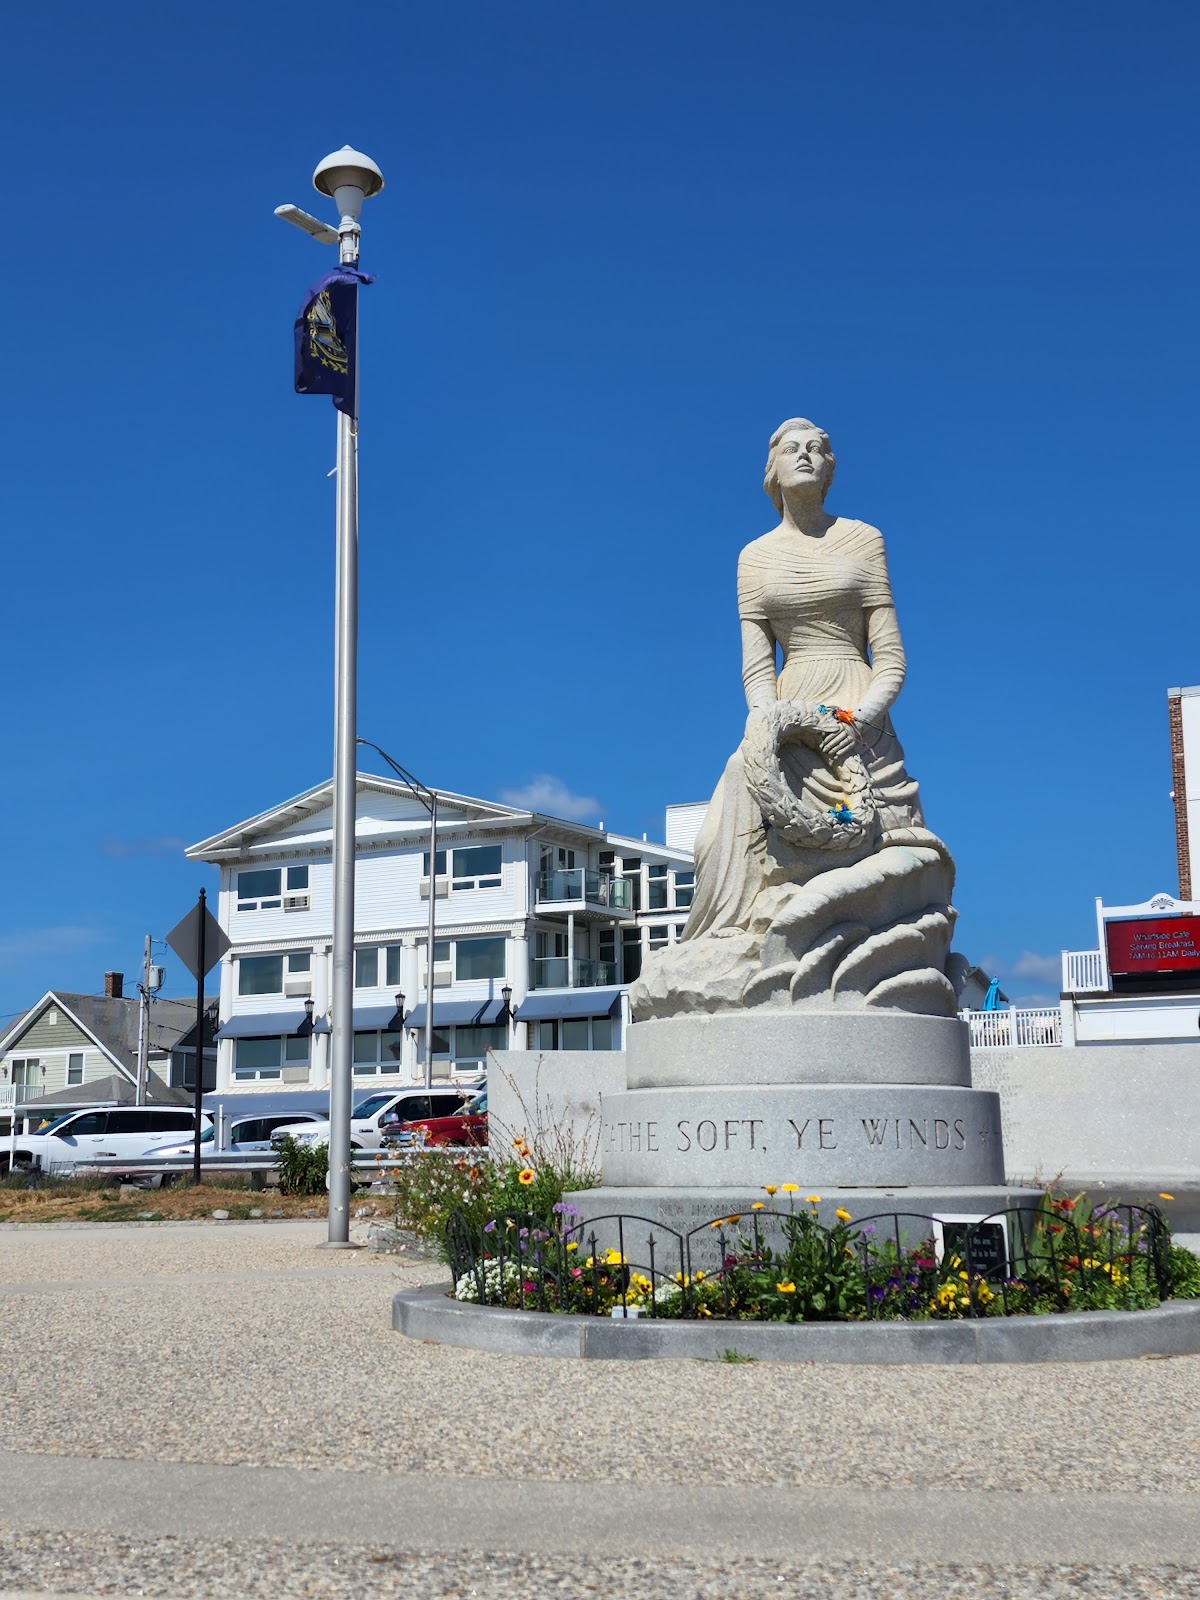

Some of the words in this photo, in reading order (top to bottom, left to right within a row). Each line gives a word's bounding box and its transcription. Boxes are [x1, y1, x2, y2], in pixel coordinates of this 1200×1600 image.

[1130, 943, 1157, 951] Serving
[1158, 941, 1195, 949] Breakfast
[677, 1119, 768, 1154] SOFT,
[787, 1117, 838, 1151] YE
[861, 1117, 967, 1152] WINDS
